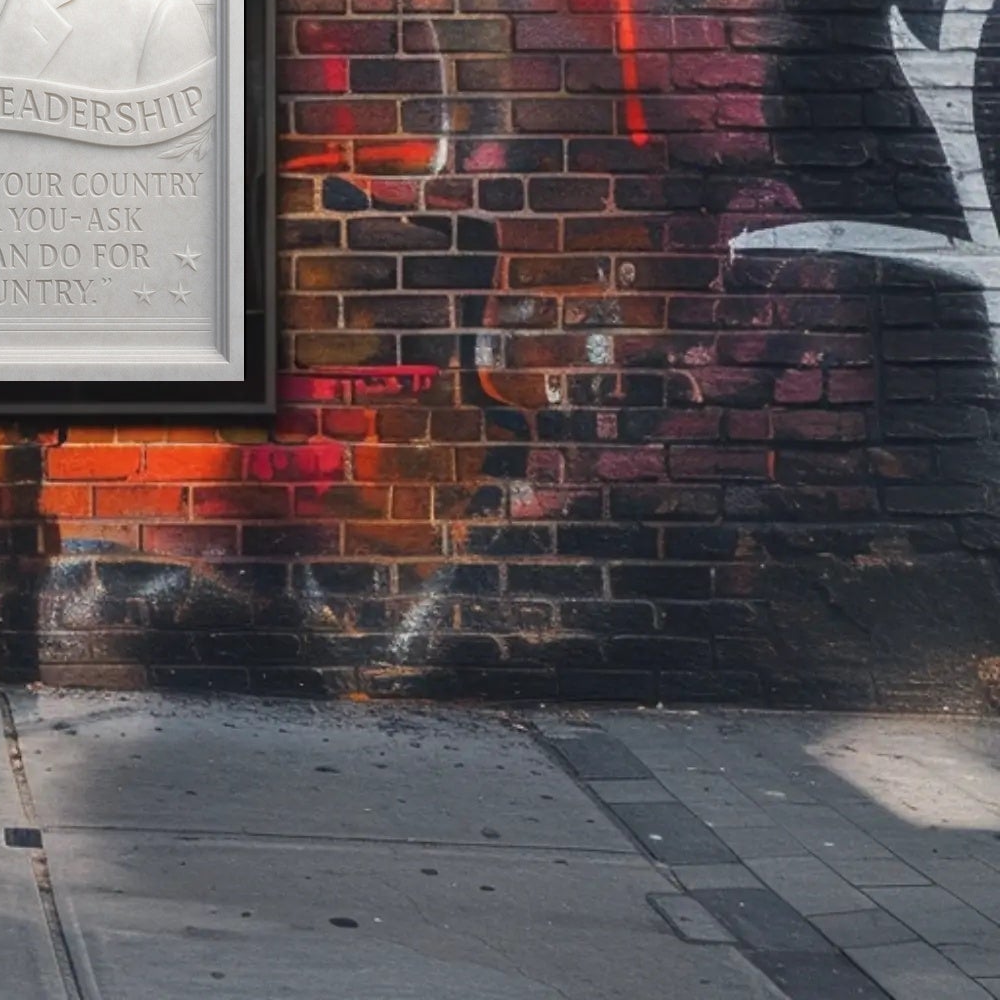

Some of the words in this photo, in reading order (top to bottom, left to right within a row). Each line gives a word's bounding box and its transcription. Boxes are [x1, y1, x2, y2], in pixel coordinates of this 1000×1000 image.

[71, 172, 204, 198] COUNTRY
[39, 243, 82, 270] DO
[92, 243, 151, 270] FOR
